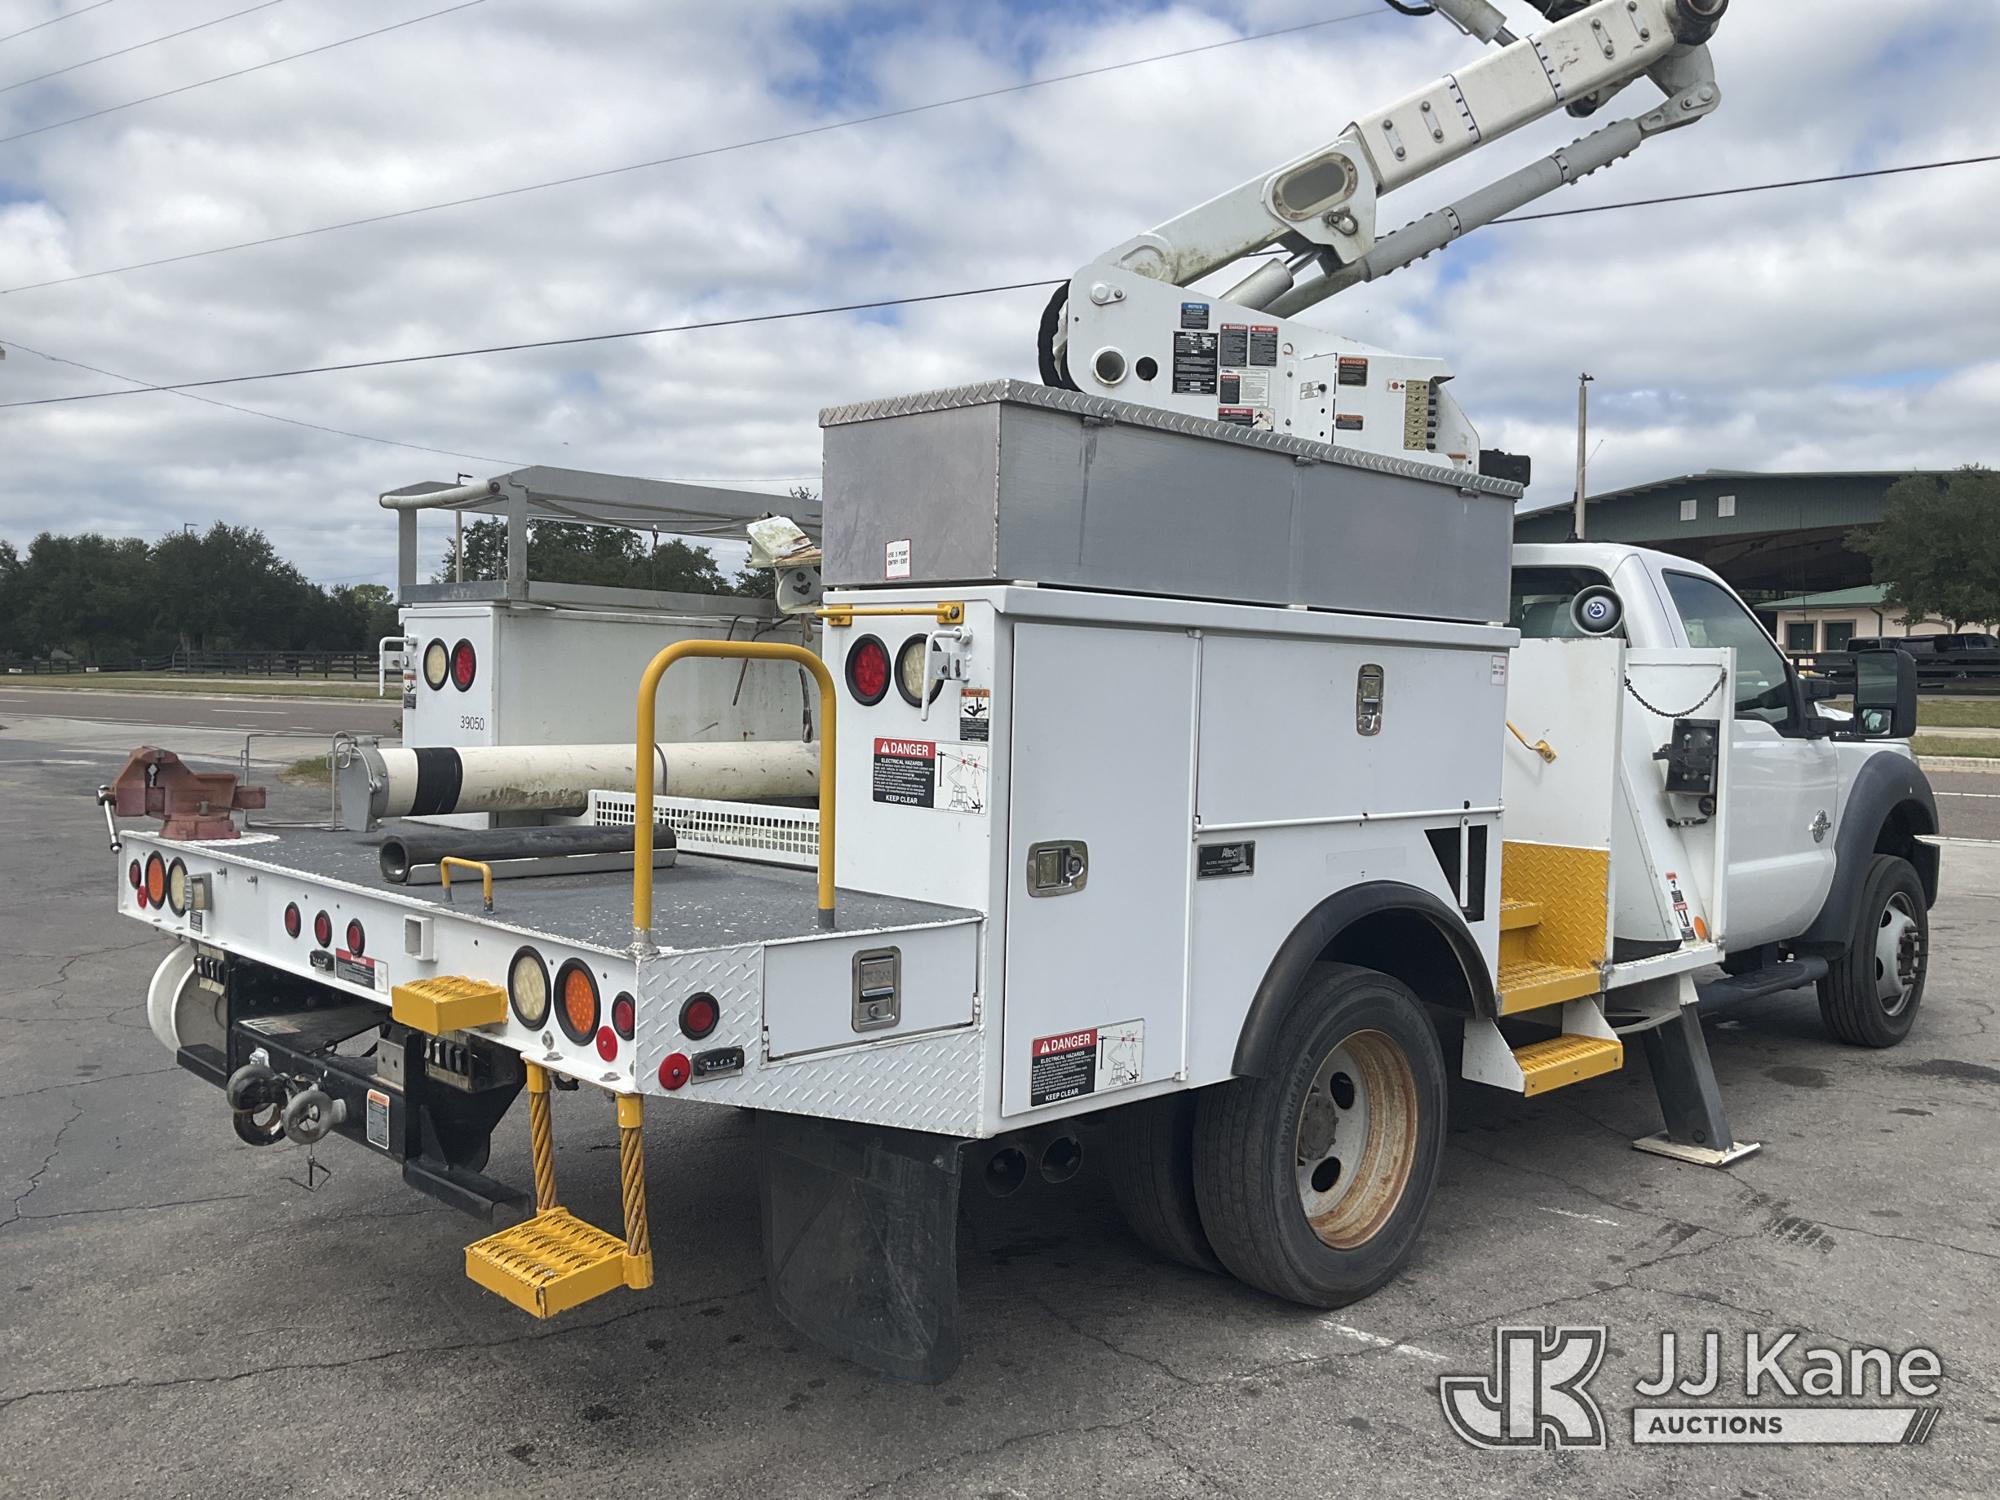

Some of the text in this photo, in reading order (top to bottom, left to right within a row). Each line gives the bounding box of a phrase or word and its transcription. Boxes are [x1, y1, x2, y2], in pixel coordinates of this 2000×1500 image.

[460, 715, 485, 731] 39050
[891, 742, 928, 756] DANGER
[881, 757, 904, 765] ELECTRICAL
[1051, 1034, 1090, 1051] DANGER
[1040, 1050, 1085, 1064] ELECTRICAL HAZARDS
[1045, 1088, 1079, 1101] KEEP CLEAR
[1281, 1093, 1298, 1146] Hybrid
